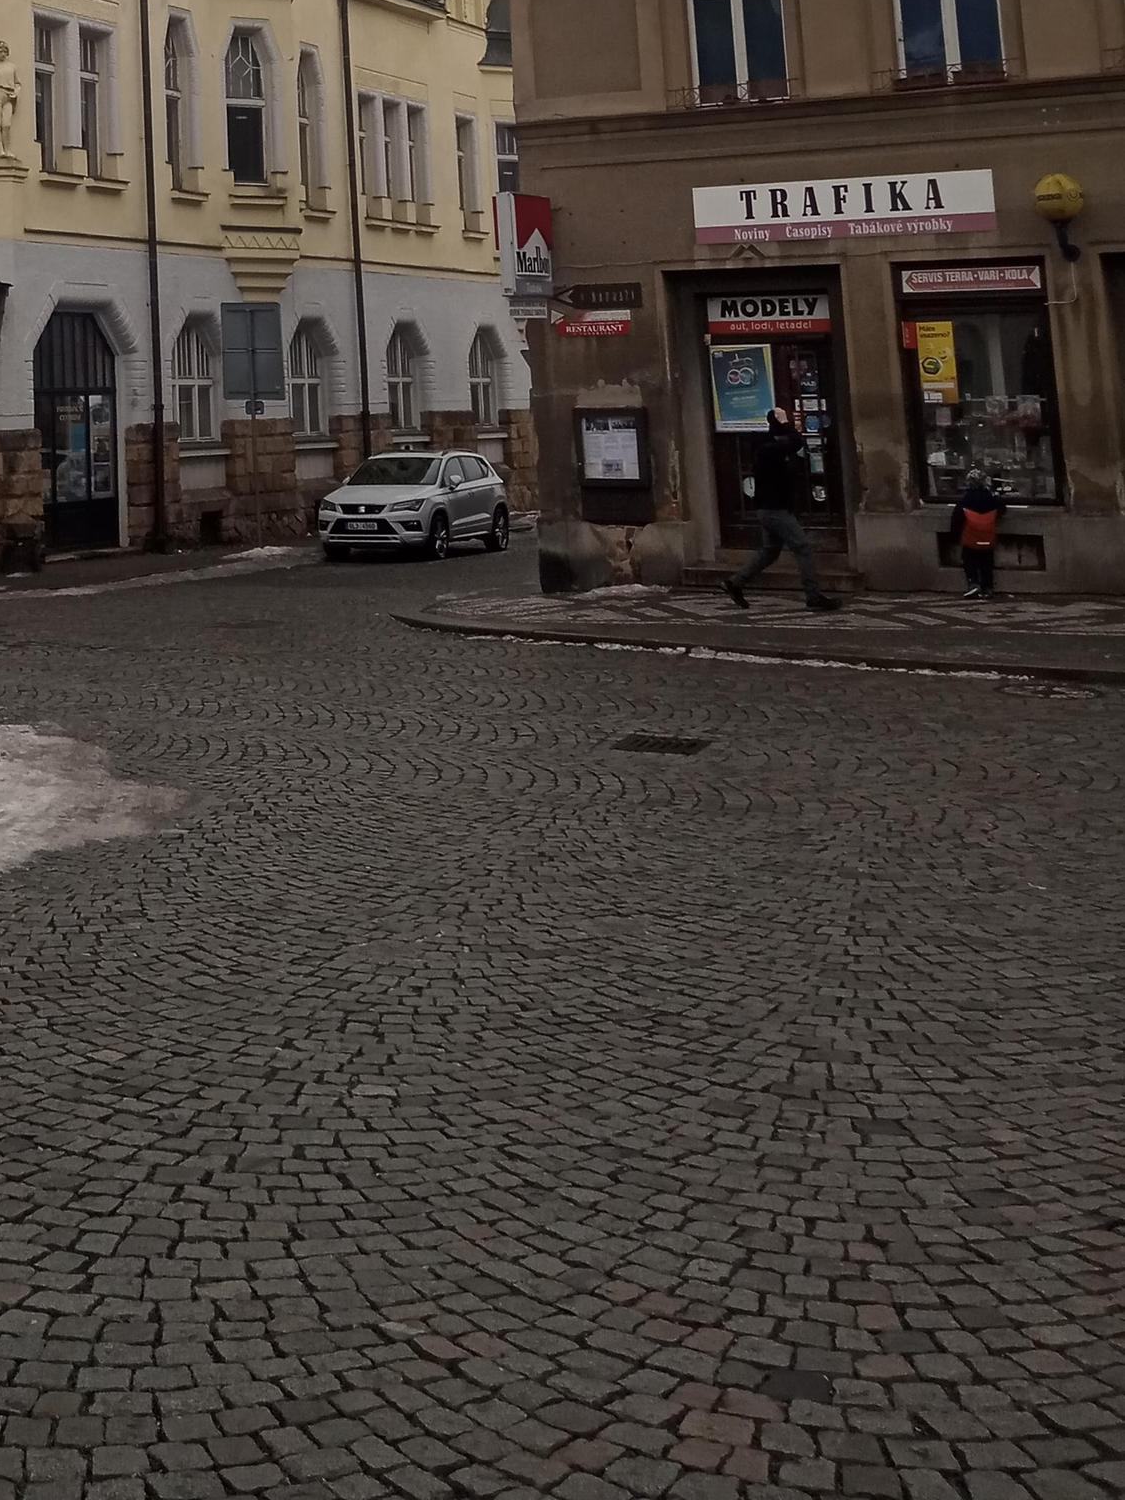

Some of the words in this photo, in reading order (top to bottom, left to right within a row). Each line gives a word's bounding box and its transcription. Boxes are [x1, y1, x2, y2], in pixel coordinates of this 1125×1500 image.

[739, 178, 945, 220] TRAFIKA
[734, 227, 772, 241] Noviny
[785, 223, 833, 239] Časopisy
[848, 222, 904, 235] Tabákové
[907, 217, 954, 234] výrobky
[911, 272, 944, 284] SERVIS
[720, 297, 818, 318] MODELY
[565, 324, 624, 333] RESTAURANT
